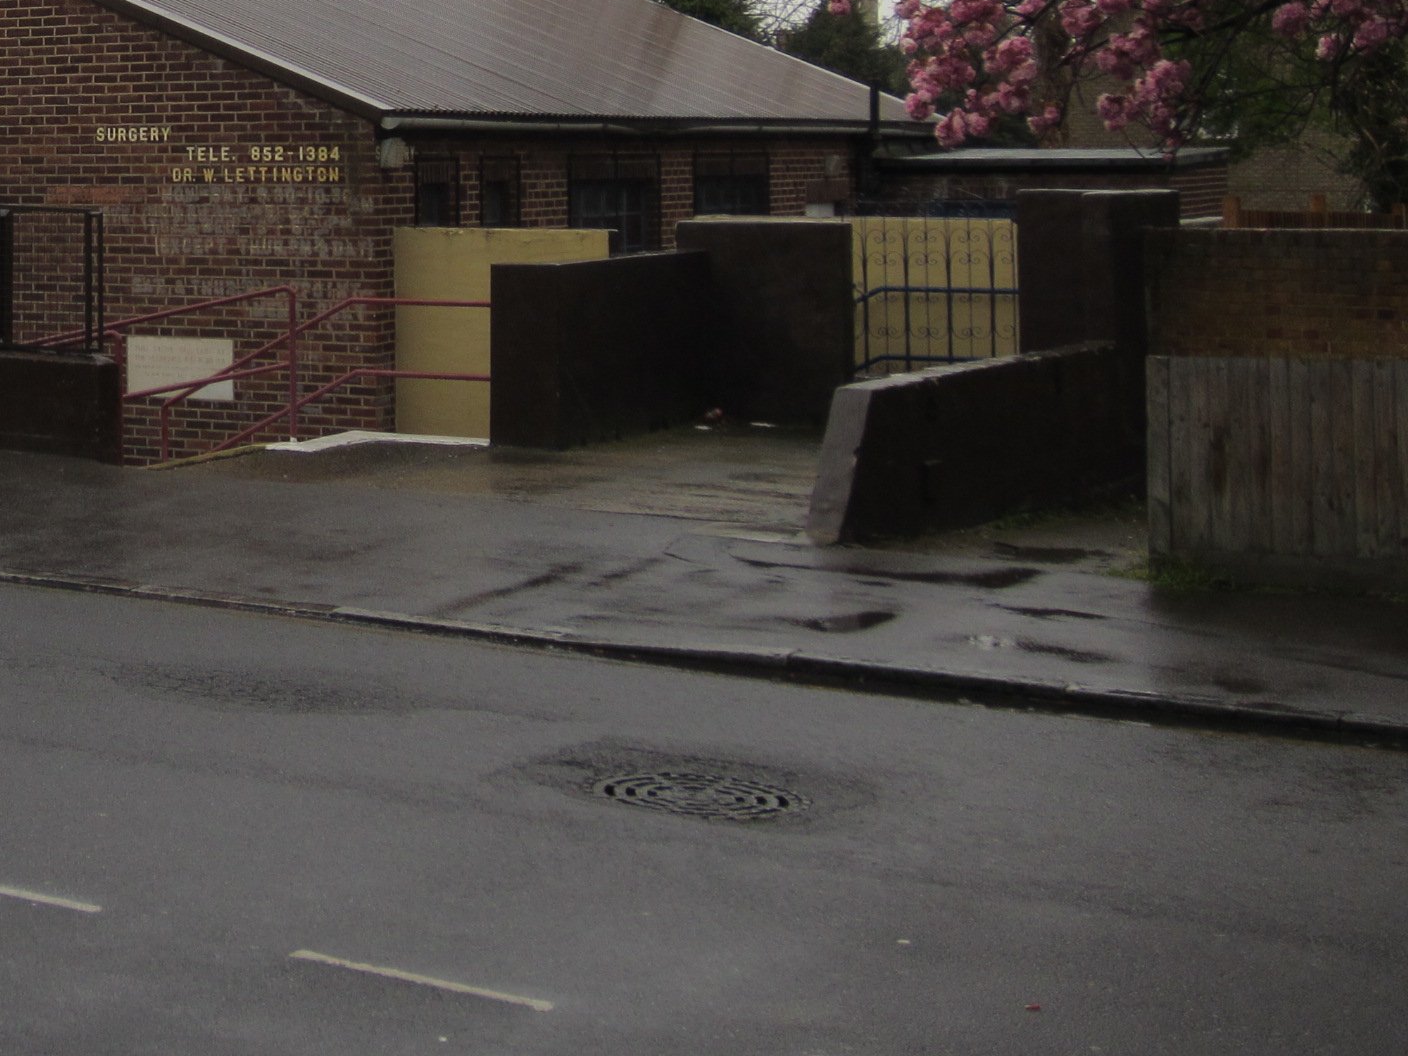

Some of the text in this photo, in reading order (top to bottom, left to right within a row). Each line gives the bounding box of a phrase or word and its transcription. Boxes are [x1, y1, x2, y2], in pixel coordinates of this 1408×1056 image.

[96, 127, 171, 142] SURGERY
[186, 146, 340, 162] TELE. 852-1384
[172, 166, 340, 183] DR. W. LETTINGTON
